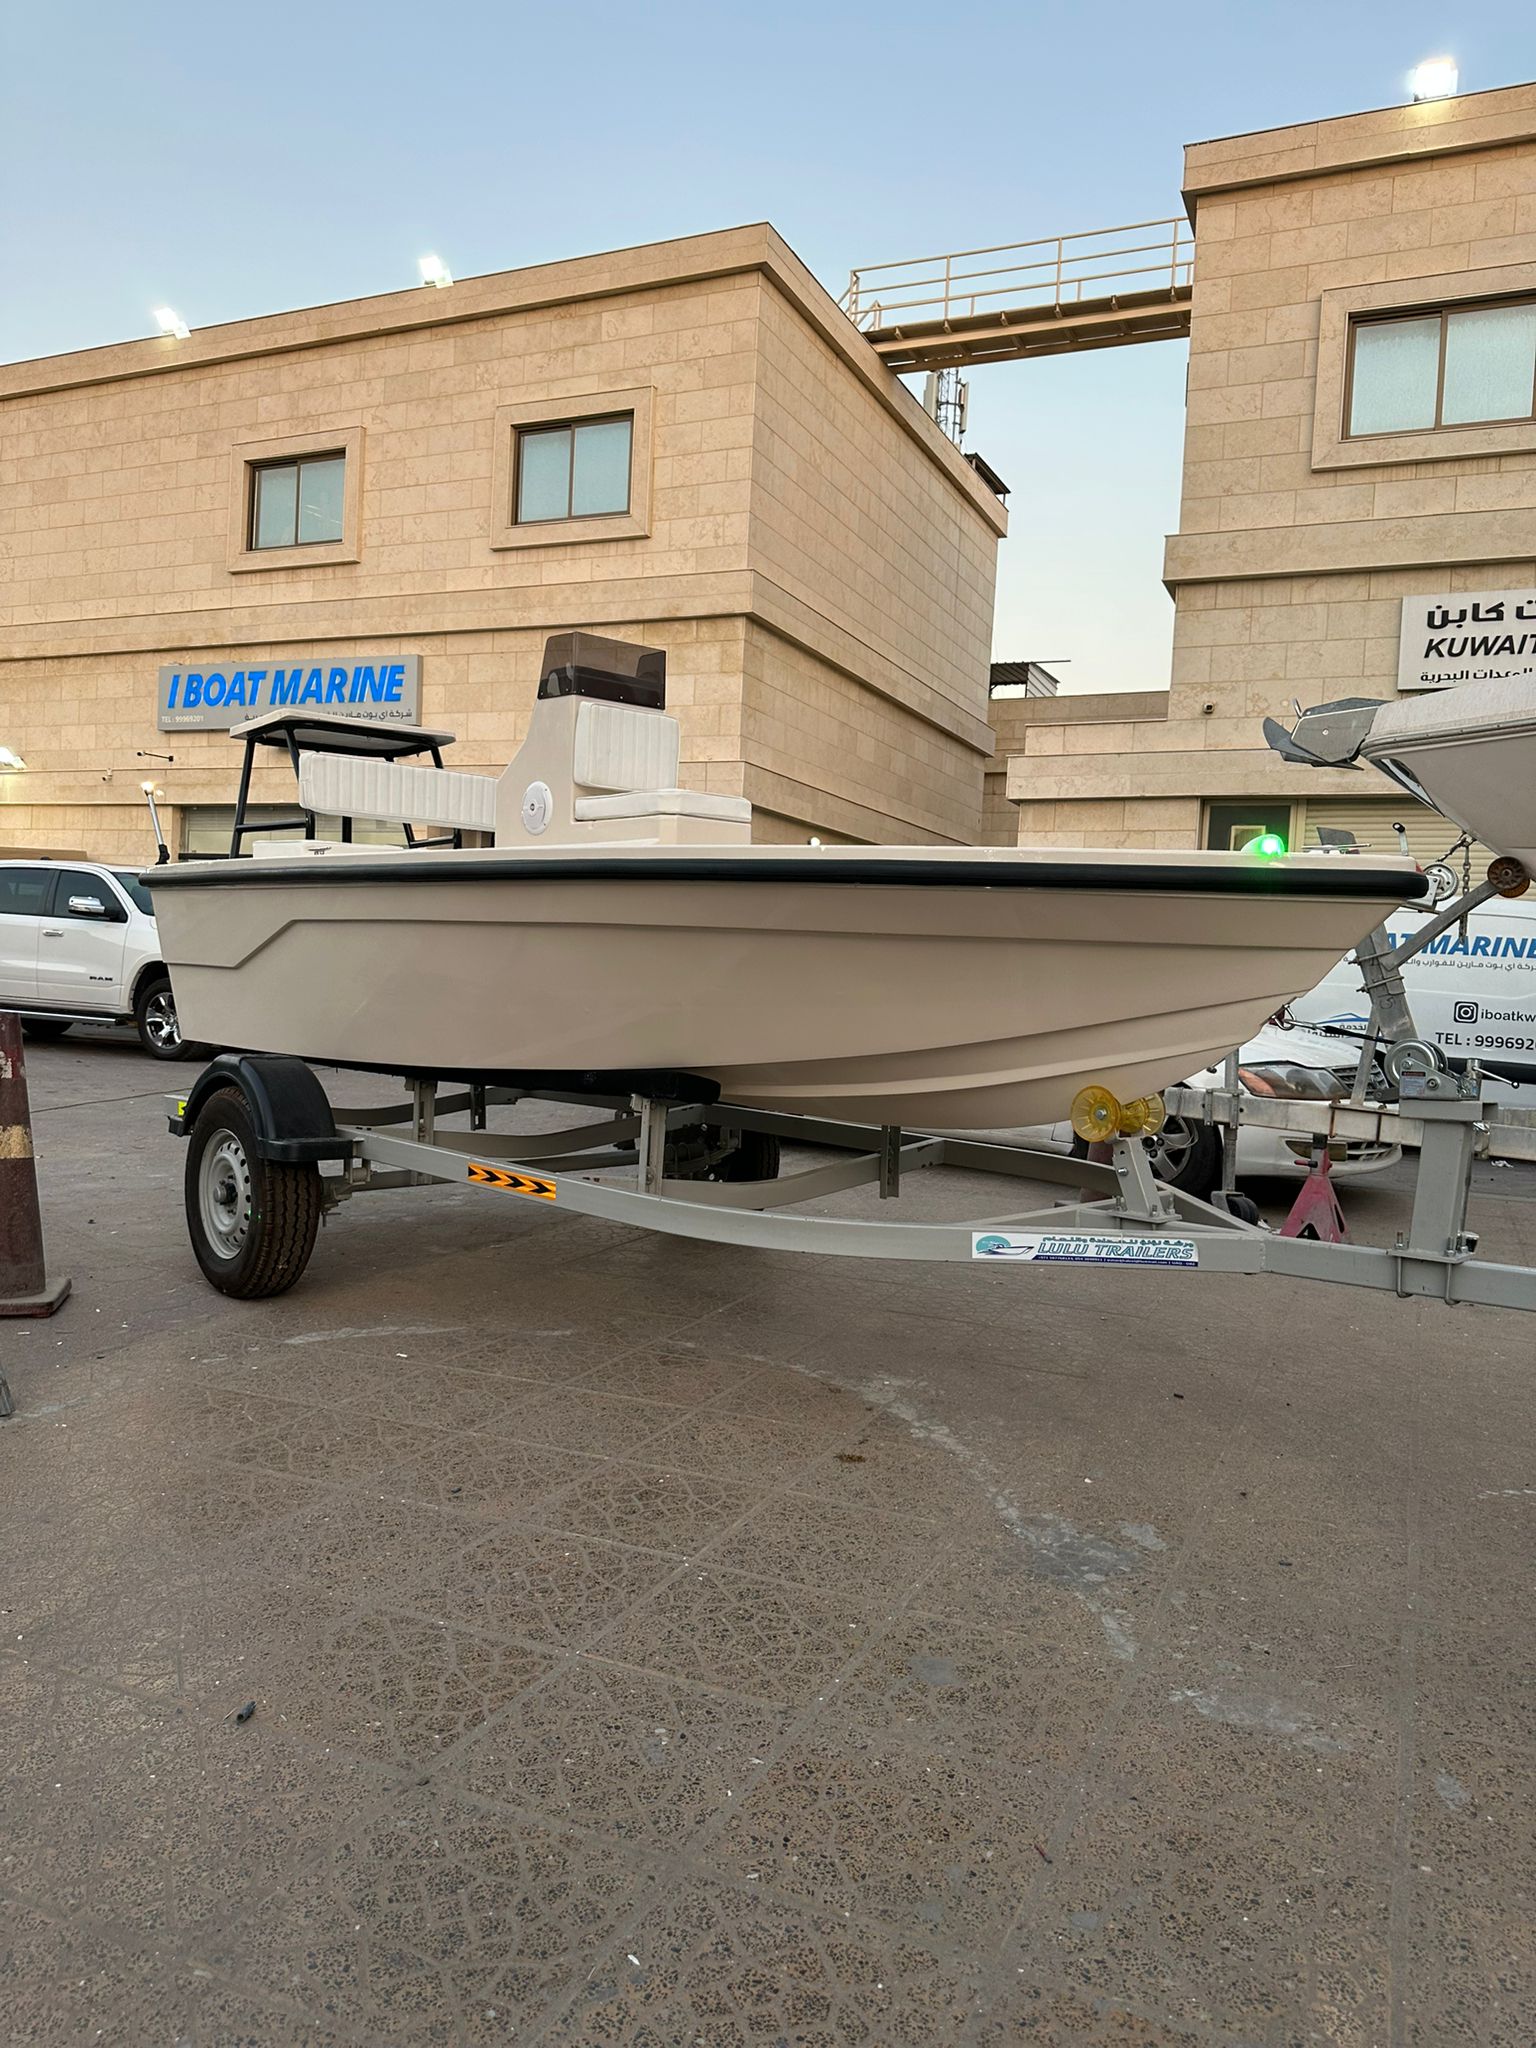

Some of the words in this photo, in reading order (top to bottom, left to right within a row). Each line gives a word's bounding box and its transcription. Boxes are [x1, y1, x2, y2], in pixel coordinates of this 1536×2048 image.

[1427, 602, 1504, 630] كابن
[1420, 670, 1469, 684] البحرية
[168, 674, 180, 709] I
[183, 670, 268, 708] BOAT
[269, 664, 406, 706] MARINE
[389, 708, 413, 719] شركة
[1435, 1032, 1462, 1045] TEL
[1474, 1034, 1536, 1051] 999692
[1037, 1242, 1089, 1255] LULU
[1094, 1244, 1194, 1259] TRAILERS
